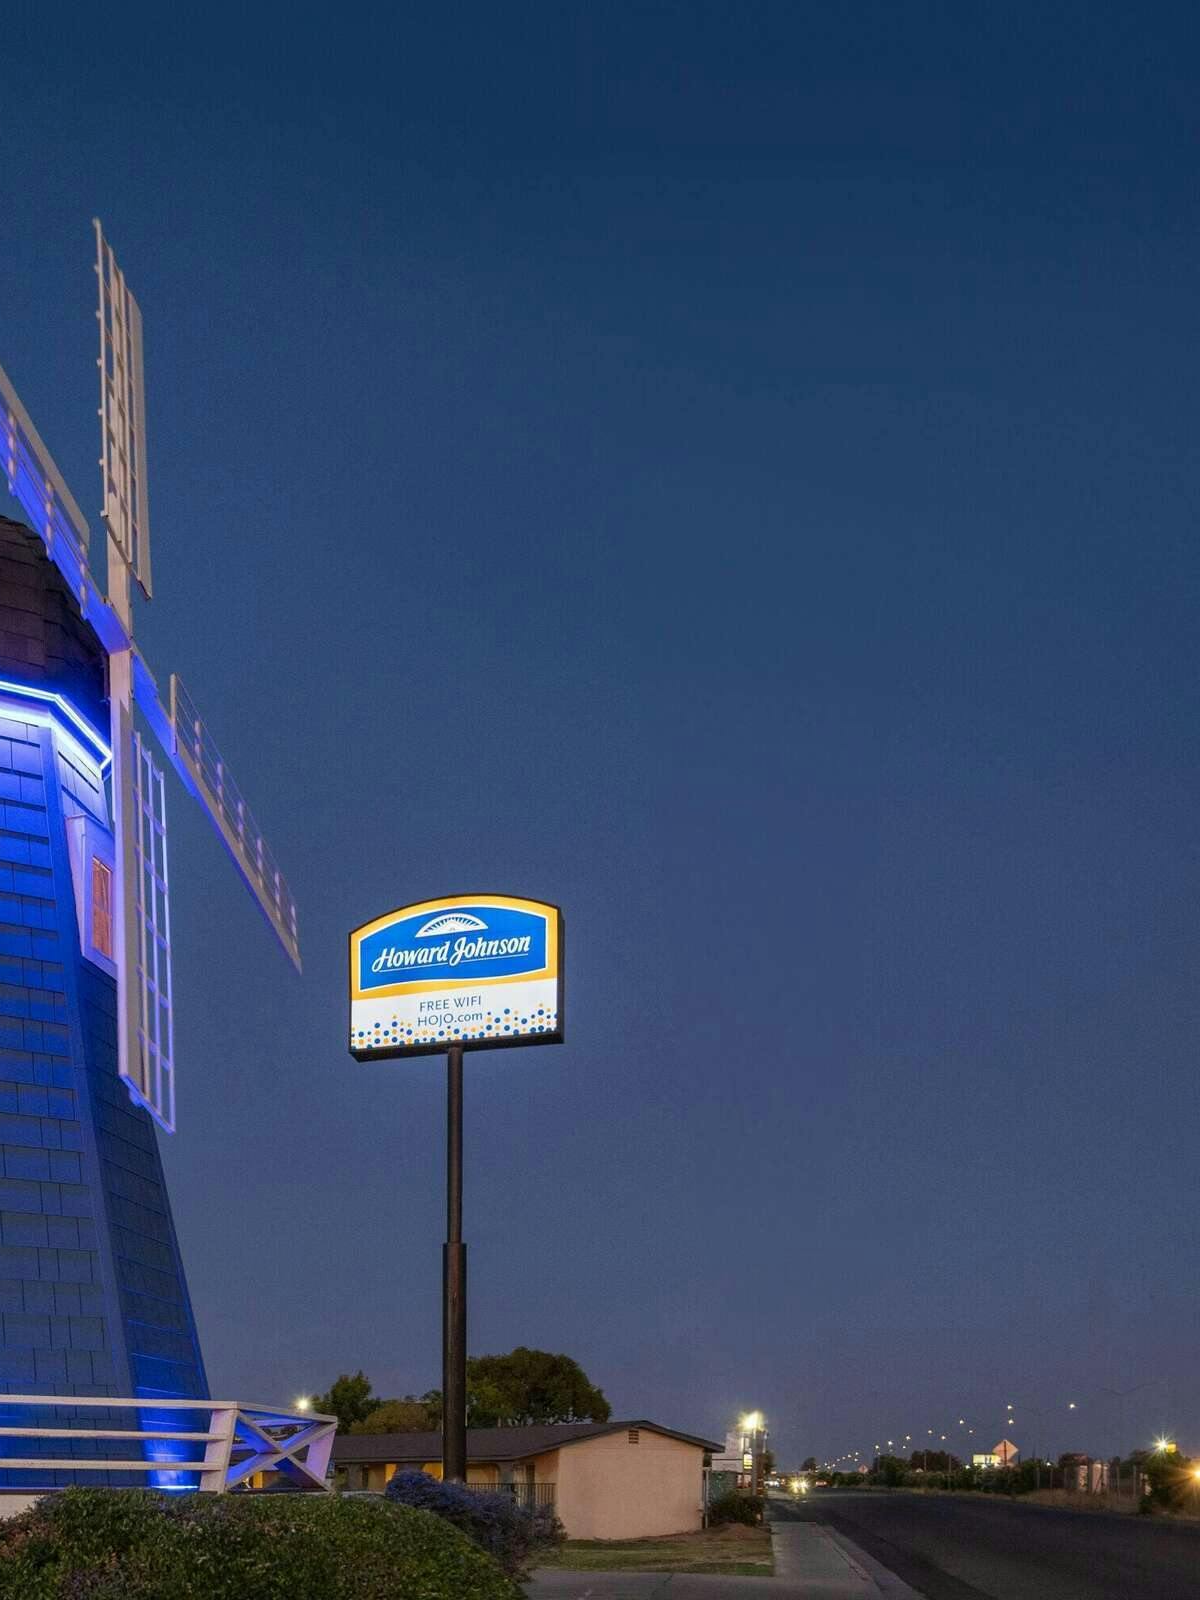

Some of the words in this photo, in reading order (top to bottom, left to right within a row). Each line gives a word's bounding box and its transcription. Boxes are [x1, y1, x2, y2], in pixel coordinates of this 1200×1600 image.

[372, 940, 449, 972] Howard
[449, 936, 531, 966] Johnson
[419, 1000, 450, 1012] FREE
[453, 995, 482, 1008] WIFI
[417, 1012, 483, 1027] HOJO.com
